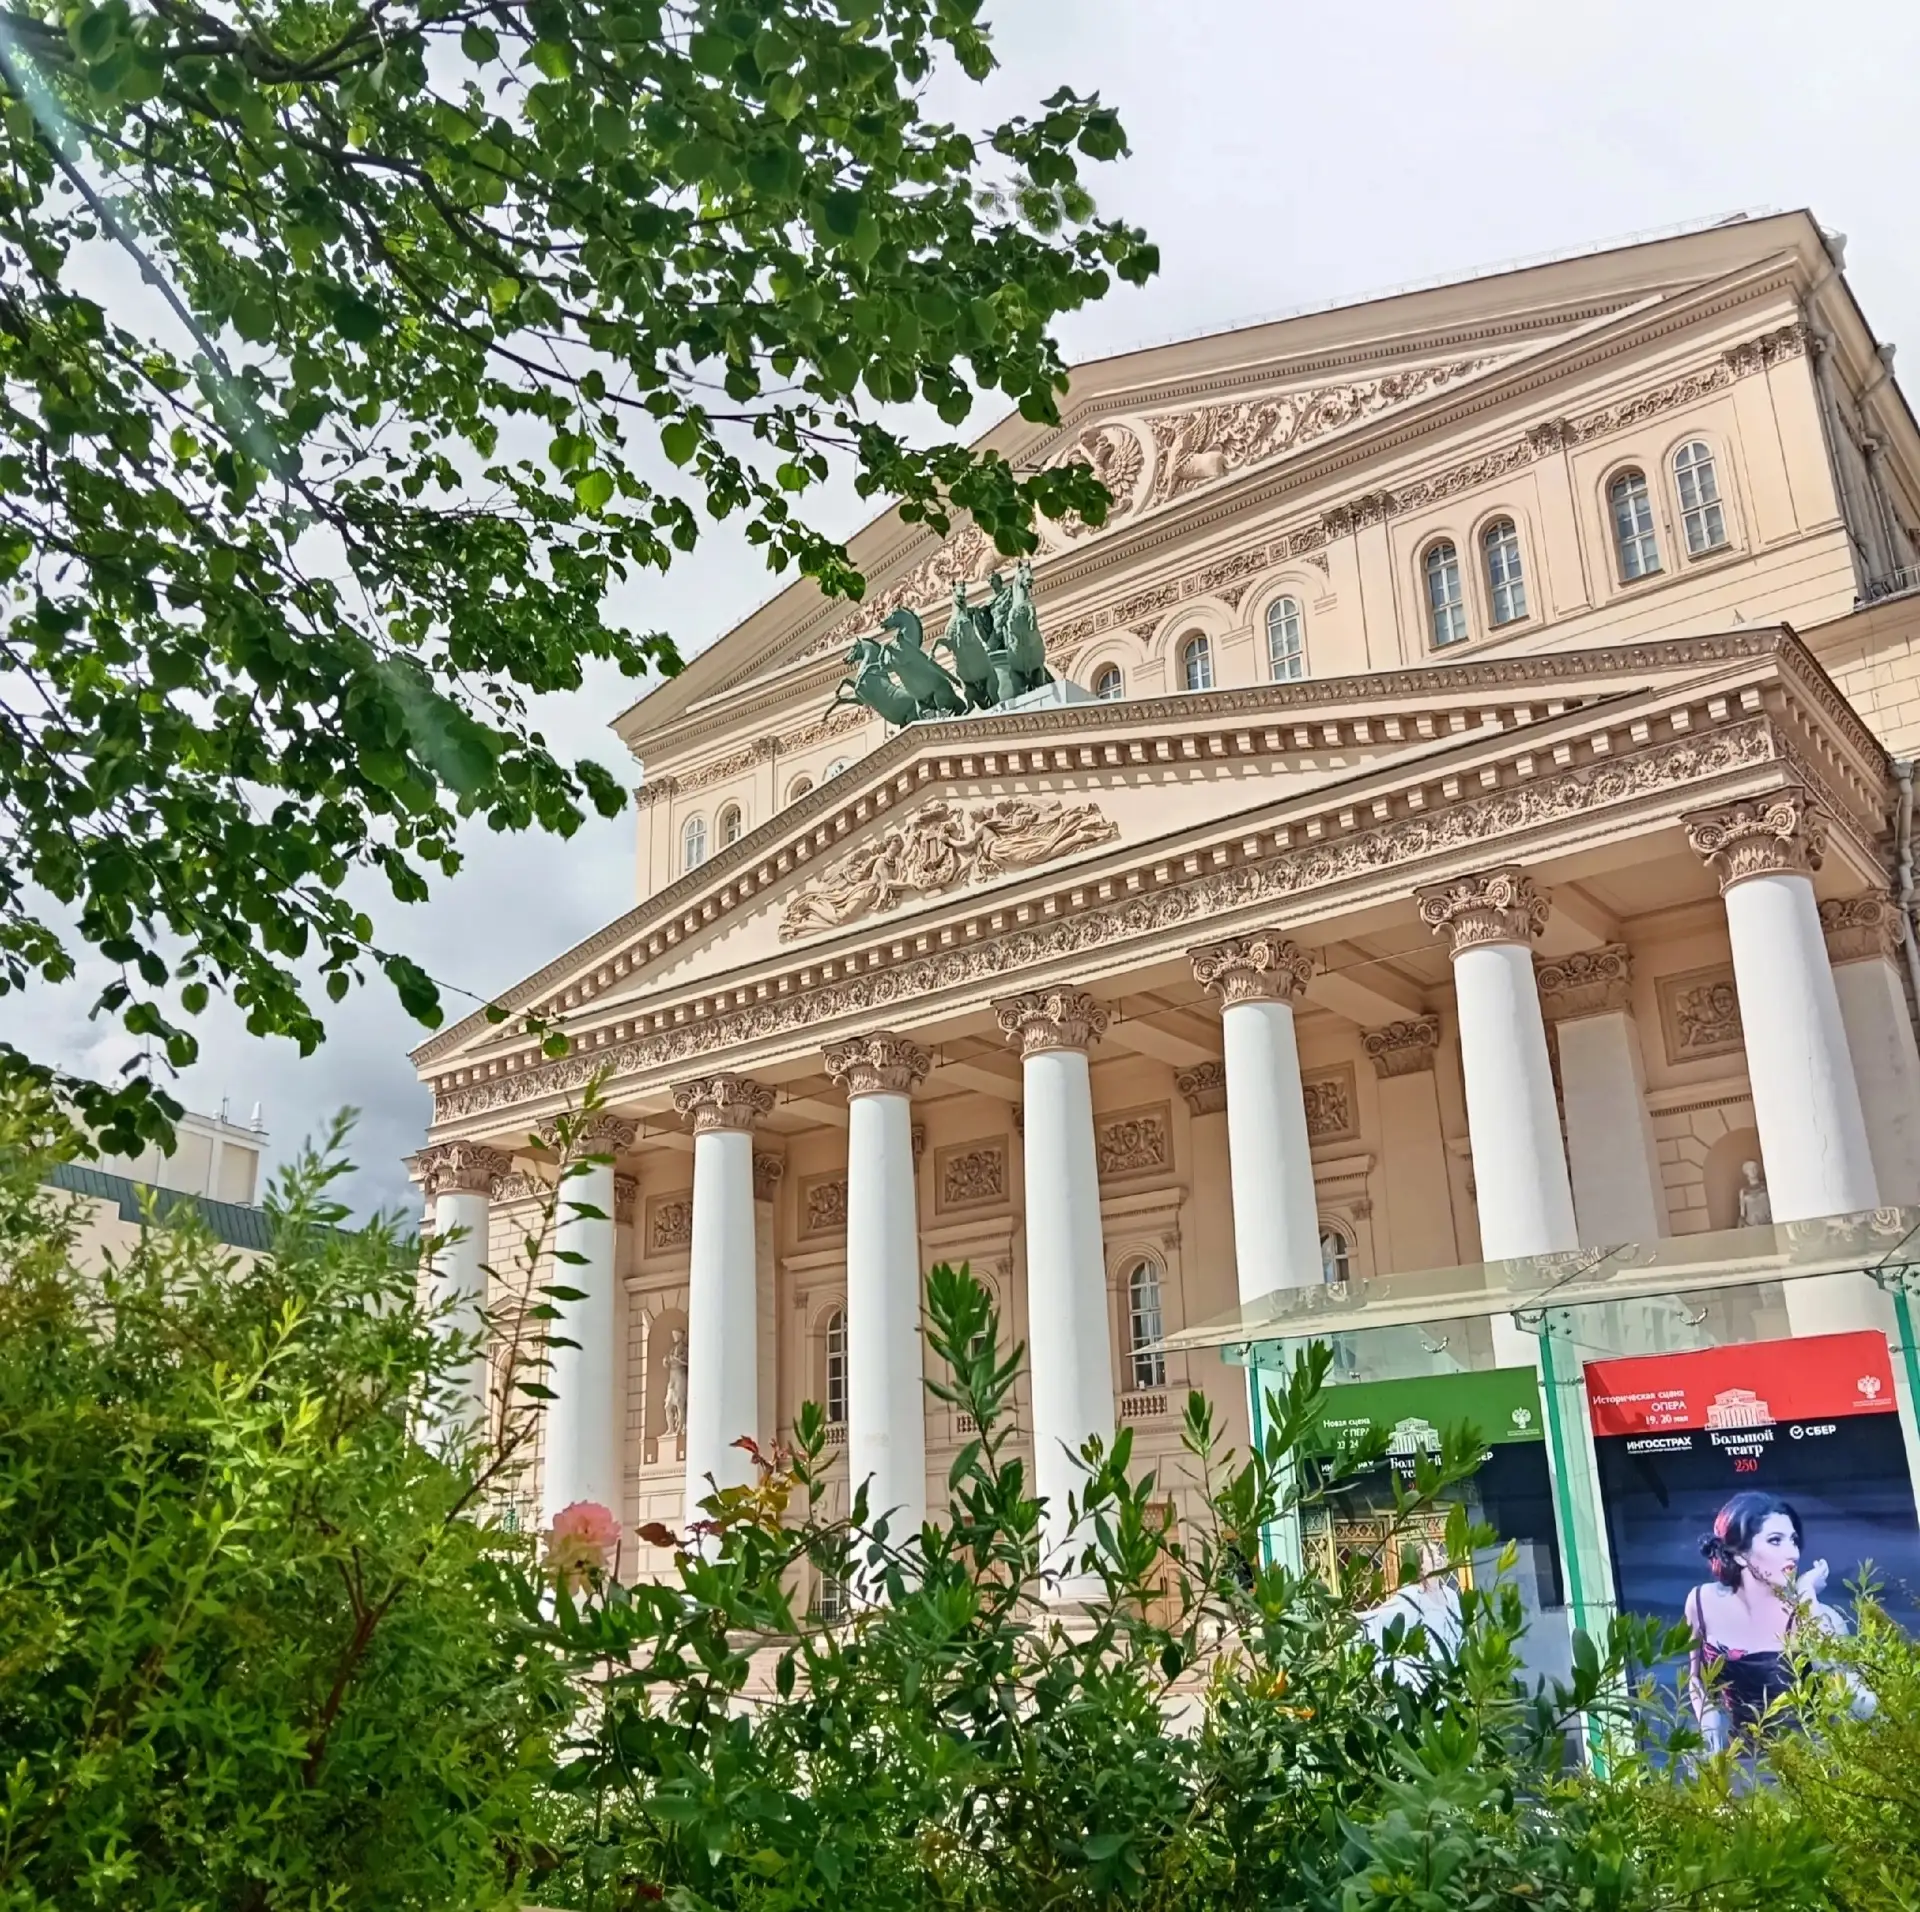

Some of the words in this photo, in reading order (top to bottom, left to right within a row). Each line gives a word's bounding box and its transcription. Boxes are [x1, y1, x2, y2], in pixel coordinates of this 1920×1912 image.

[1593, 1392, 1656, 1405] Историческая
[1658, 1390, 1685, 1400] сцена
[1651, 1401, 1687, 1412] ОПЕРА
[1323, 1420, 1347, 1429] Новая
[1348, 1418, 1371, 1427] сцена
[1660, 1414, 1672, 1424] 20
[1805, 1424, 1837, 1436] СБЕР
[1627, 1436, 1692, 1450] ИНГОССТРАХ
[1710, 1429, 1774, 1446] Большой
[1725, 1444, 1764, 1457] театр
[1734, 1458, 1758, 1472] 250
